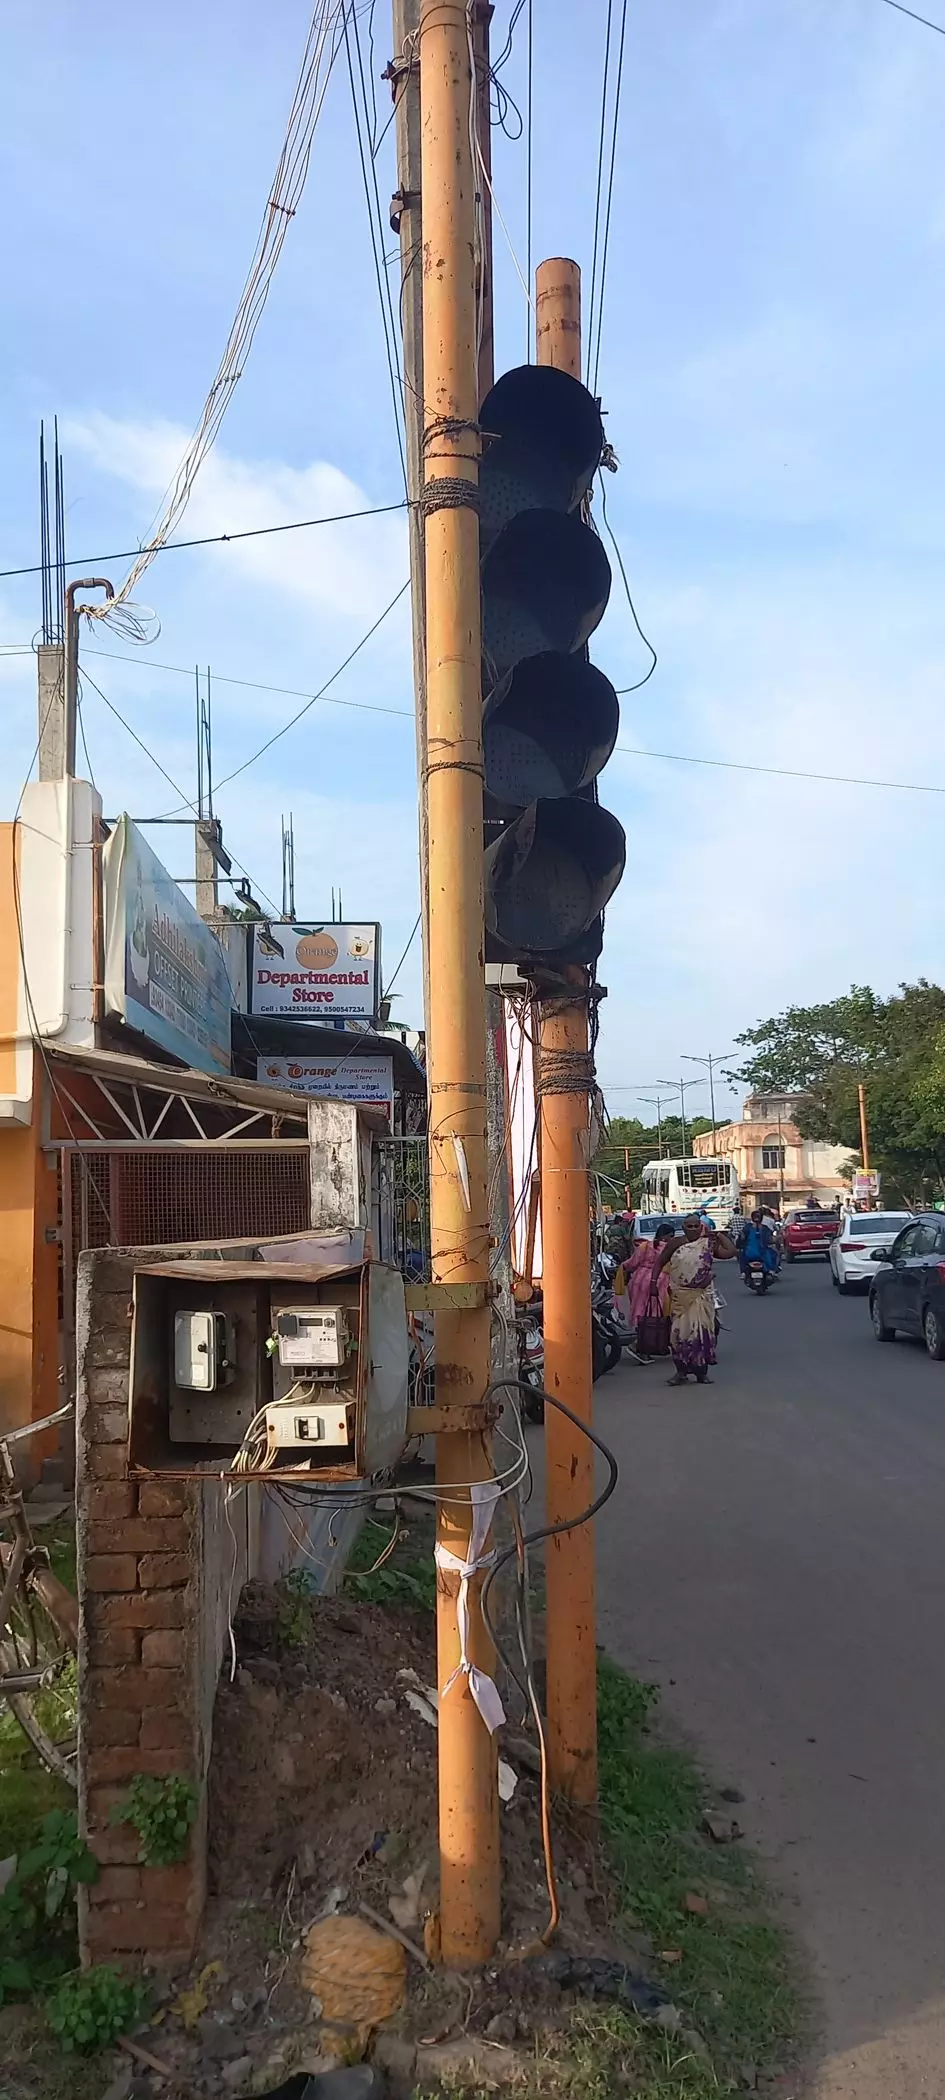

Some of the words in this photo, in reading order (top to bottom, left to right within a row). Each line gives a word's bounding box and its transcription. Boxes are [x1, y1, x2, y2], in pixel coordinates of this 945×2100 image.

[296, 946, 337, 959] Orange
[256, 969, 370, 988] Departmental
[292, 987, 334, 1003] Store
[288, 1064, 337, 1079] Orange
